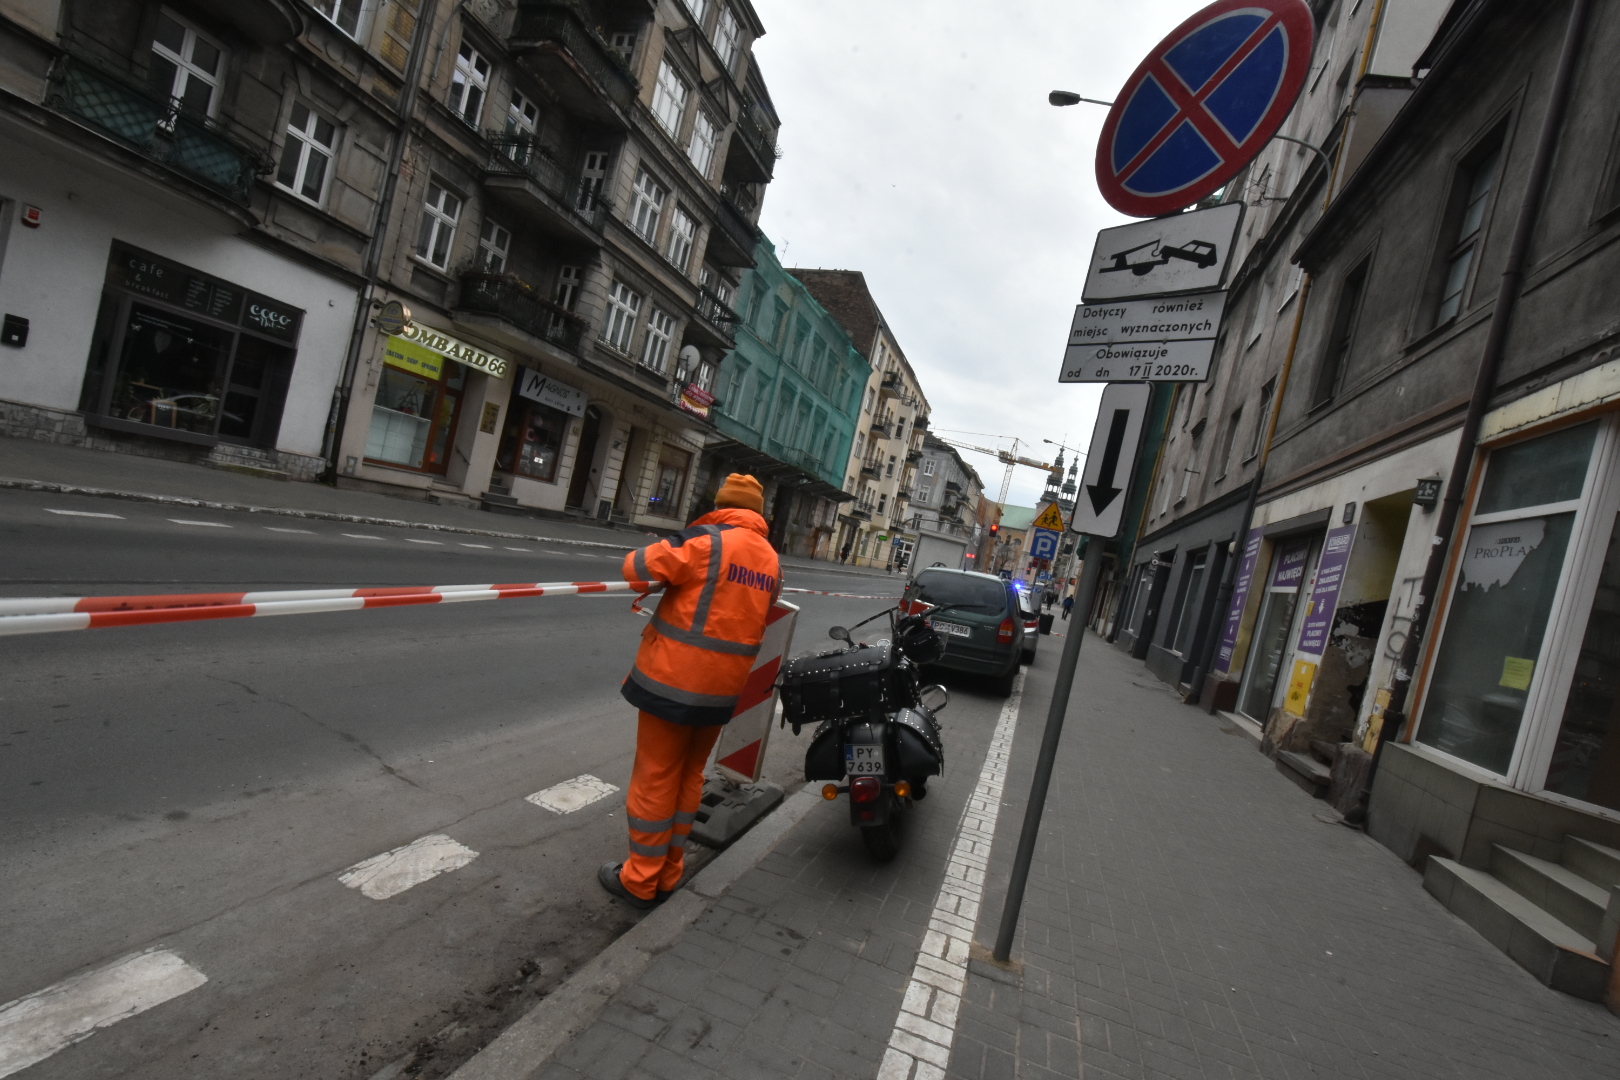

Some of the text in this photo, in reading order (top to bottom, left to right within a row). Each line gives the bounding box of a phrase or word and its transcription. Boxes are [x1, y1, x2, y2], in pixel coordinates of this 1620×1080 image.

[129, 259, 164, 278] cafe
[135, 273, 142, 282] &
[125, 279, 169, 299] breakfast
[1083, 299, 1203, 319] Dotyczy również
[1073, 319, 1212, 338] miejsc wyznaczonych
[402, 322, 488, 367] OMBARD
[1096, 347, 1169, 361] Obowiązuje
[1067, 368, 1082, 378] od
[1095, 367, 1110, 378] dn
[727, 562, 775, 593] DROMO
[856, 748, 874, 759] PY
[848, 761, 882, 773] 7639
